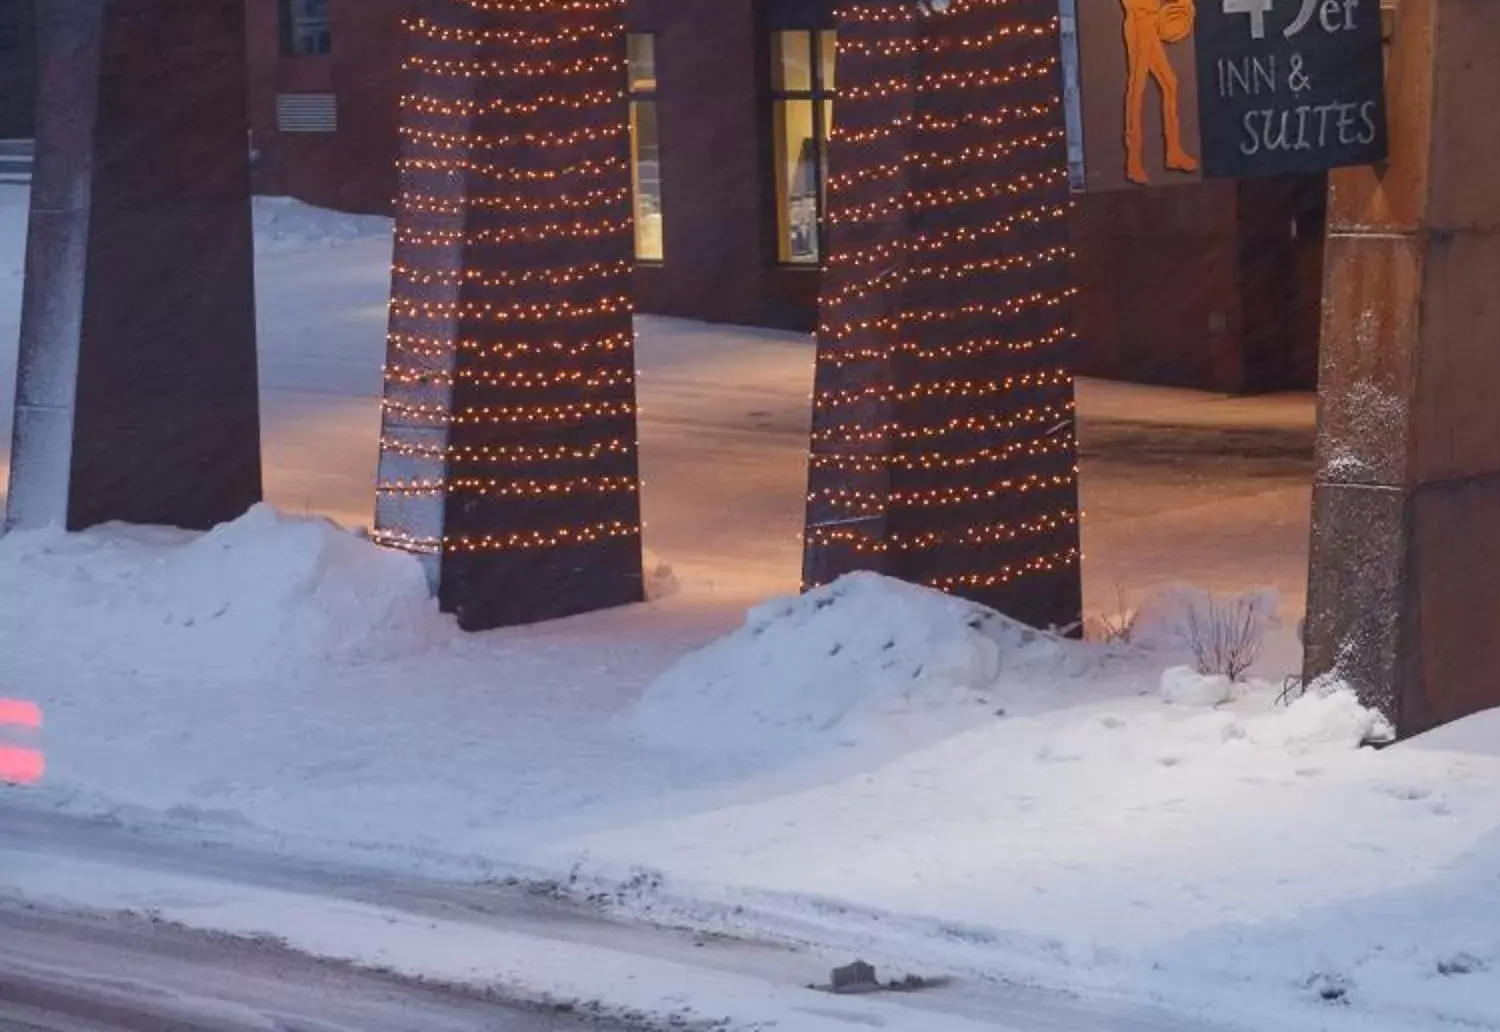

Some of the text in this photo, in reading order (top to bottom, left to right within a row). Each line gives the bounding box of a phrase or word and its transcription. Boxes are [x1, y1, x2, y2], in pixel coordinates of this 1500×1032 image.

[1217, 53, 1311, 97] INN &
[1240, 101, 1377, 155] SUITES
